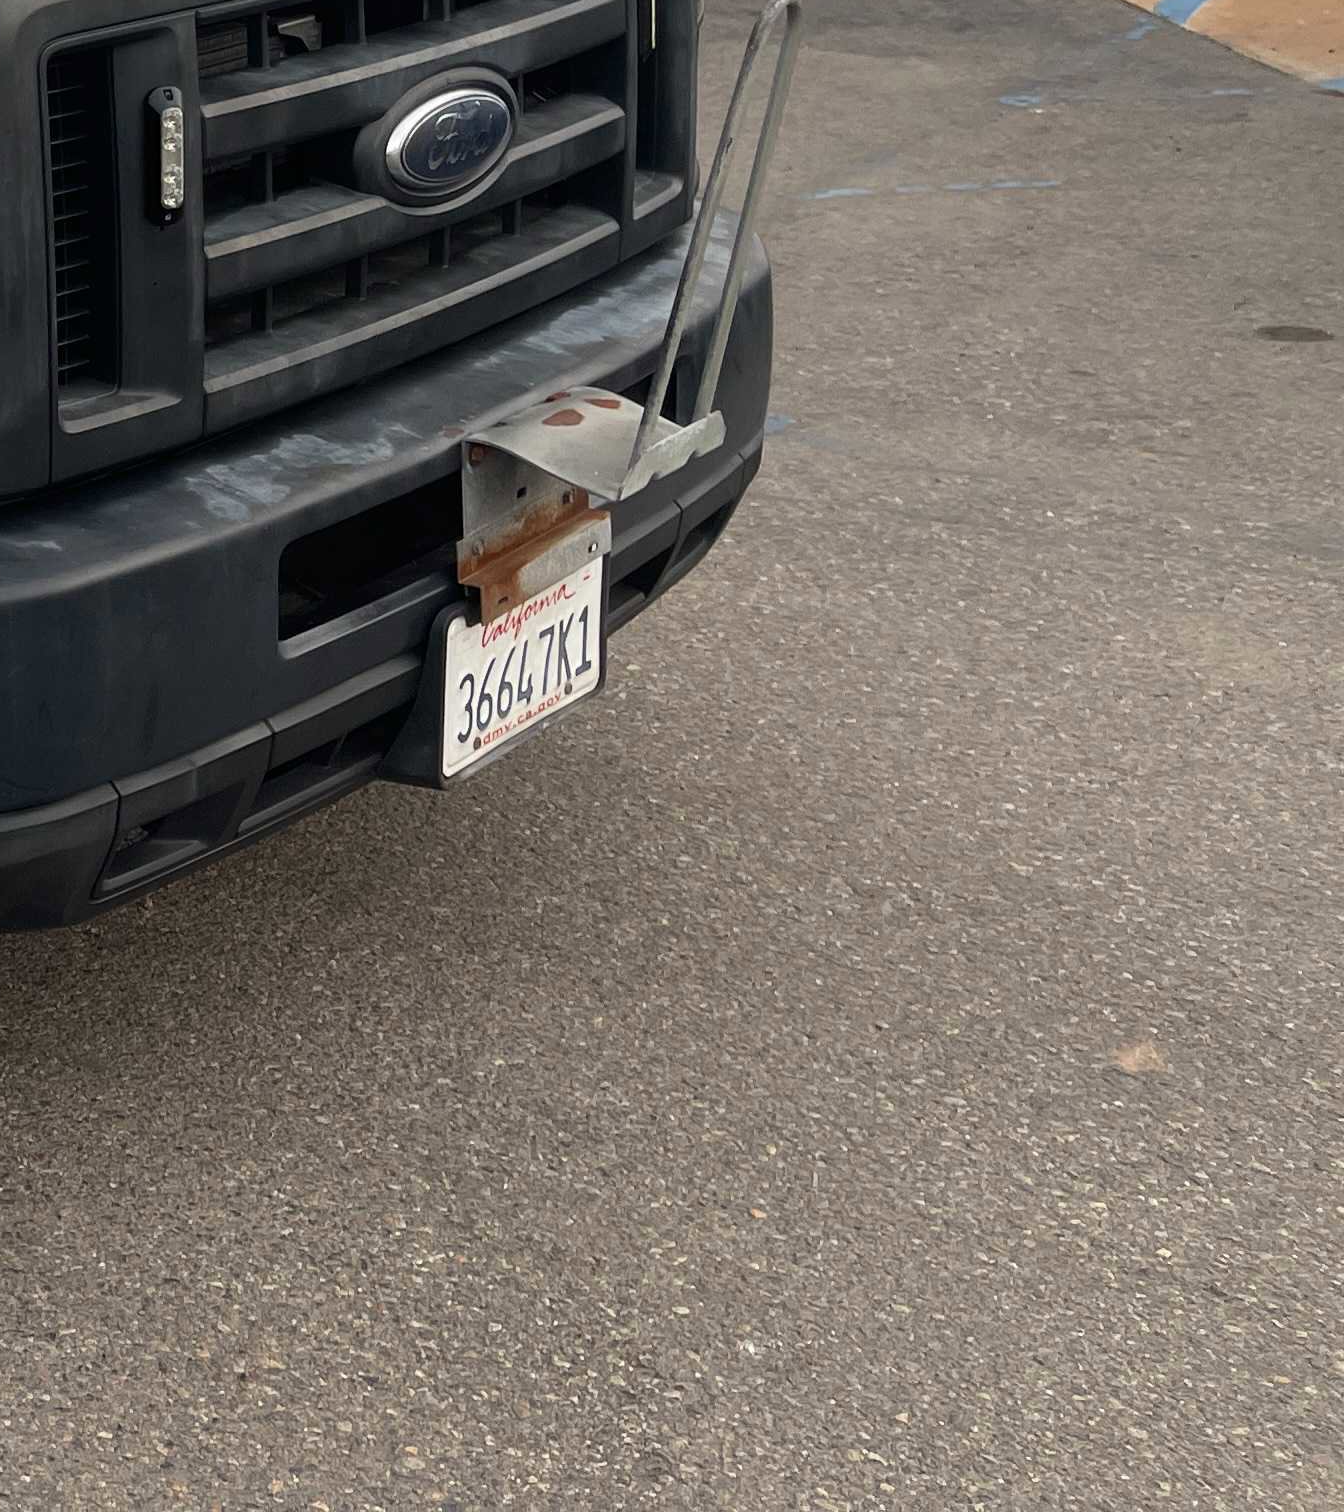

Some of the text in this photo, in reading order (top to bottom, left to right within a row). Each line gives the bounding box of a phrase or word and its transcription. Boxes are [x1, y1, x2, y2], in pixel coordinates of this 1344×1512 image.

[481, 583, 577, 649] California
[457, 604, 593, 744] 36647K1
[483, 693, 562, 745] dmv.ca.gov
